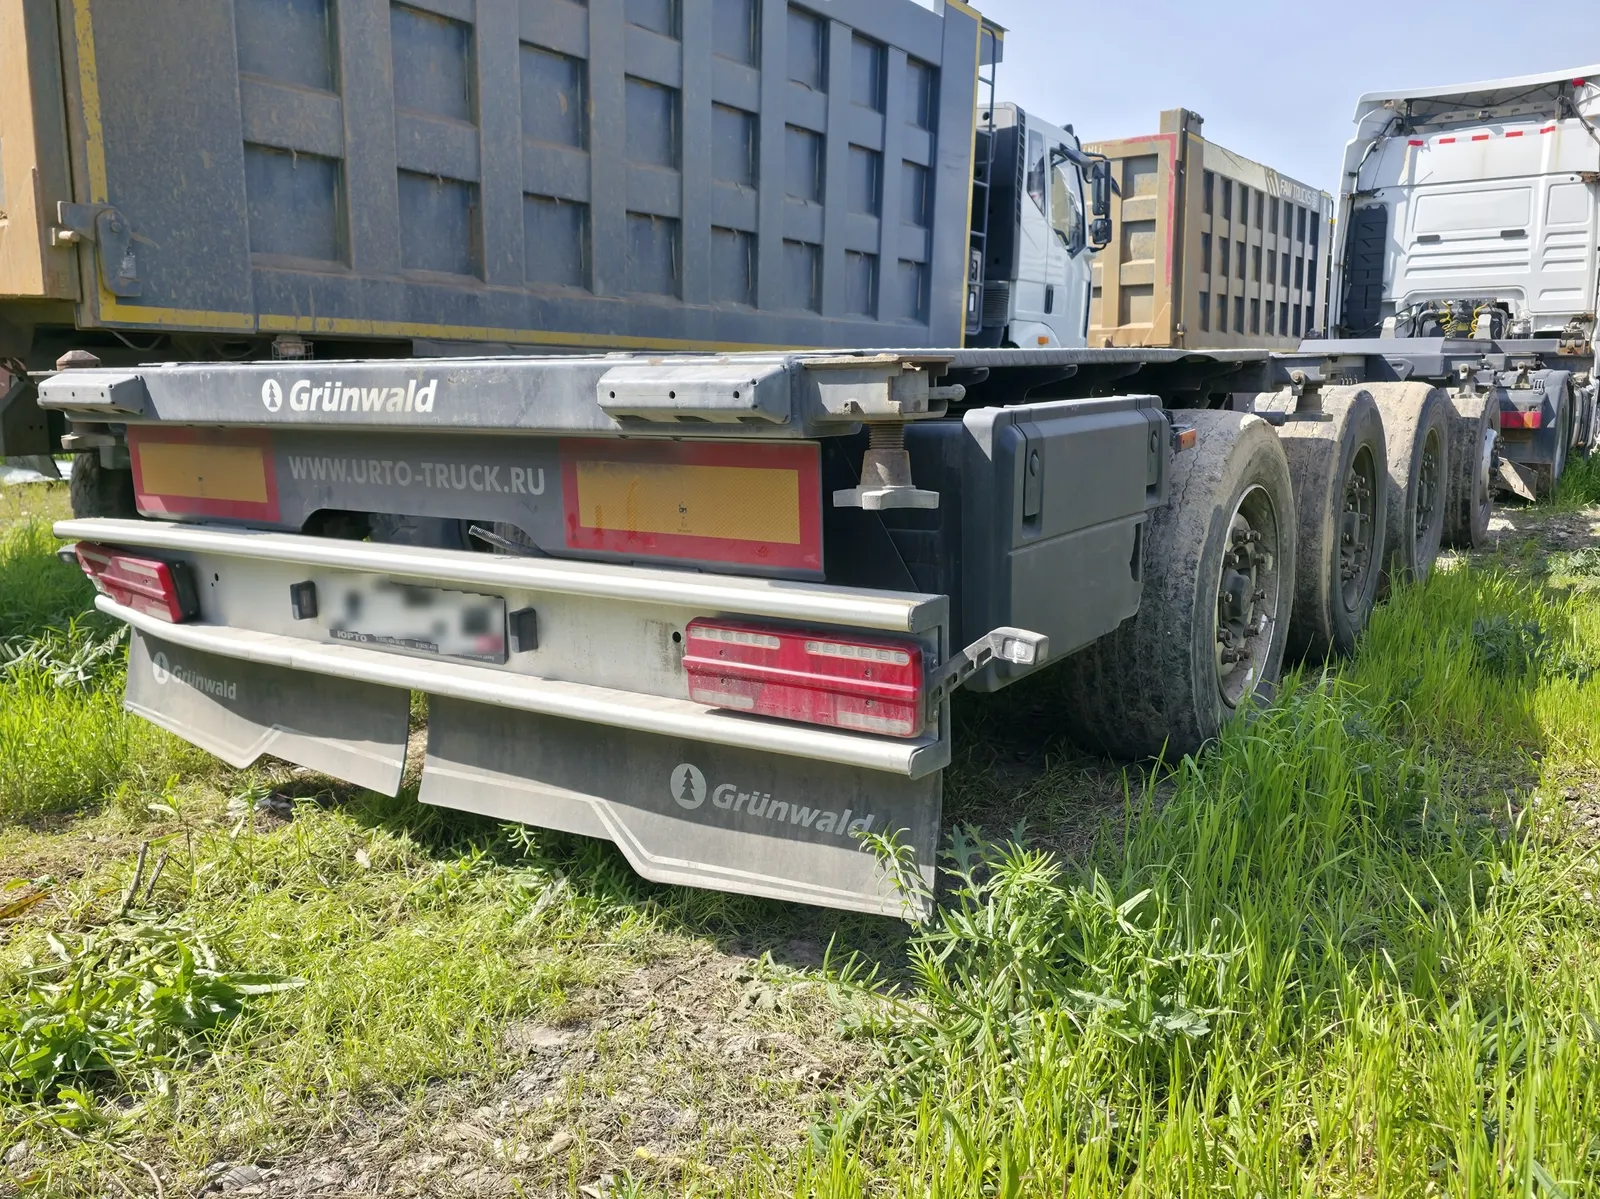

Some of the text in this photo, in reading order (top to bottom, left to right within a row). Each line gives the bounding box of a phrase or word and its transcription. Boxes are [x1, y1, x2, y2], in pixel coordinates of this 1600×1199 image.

[289, 379, 438, 413] Grünwald
[288, 455, 545, 496] WWW.URTO-TRUCK.RU
[171, 665, 237, 701] Grünwald
[712, 783, 875, 839] Grünwald
